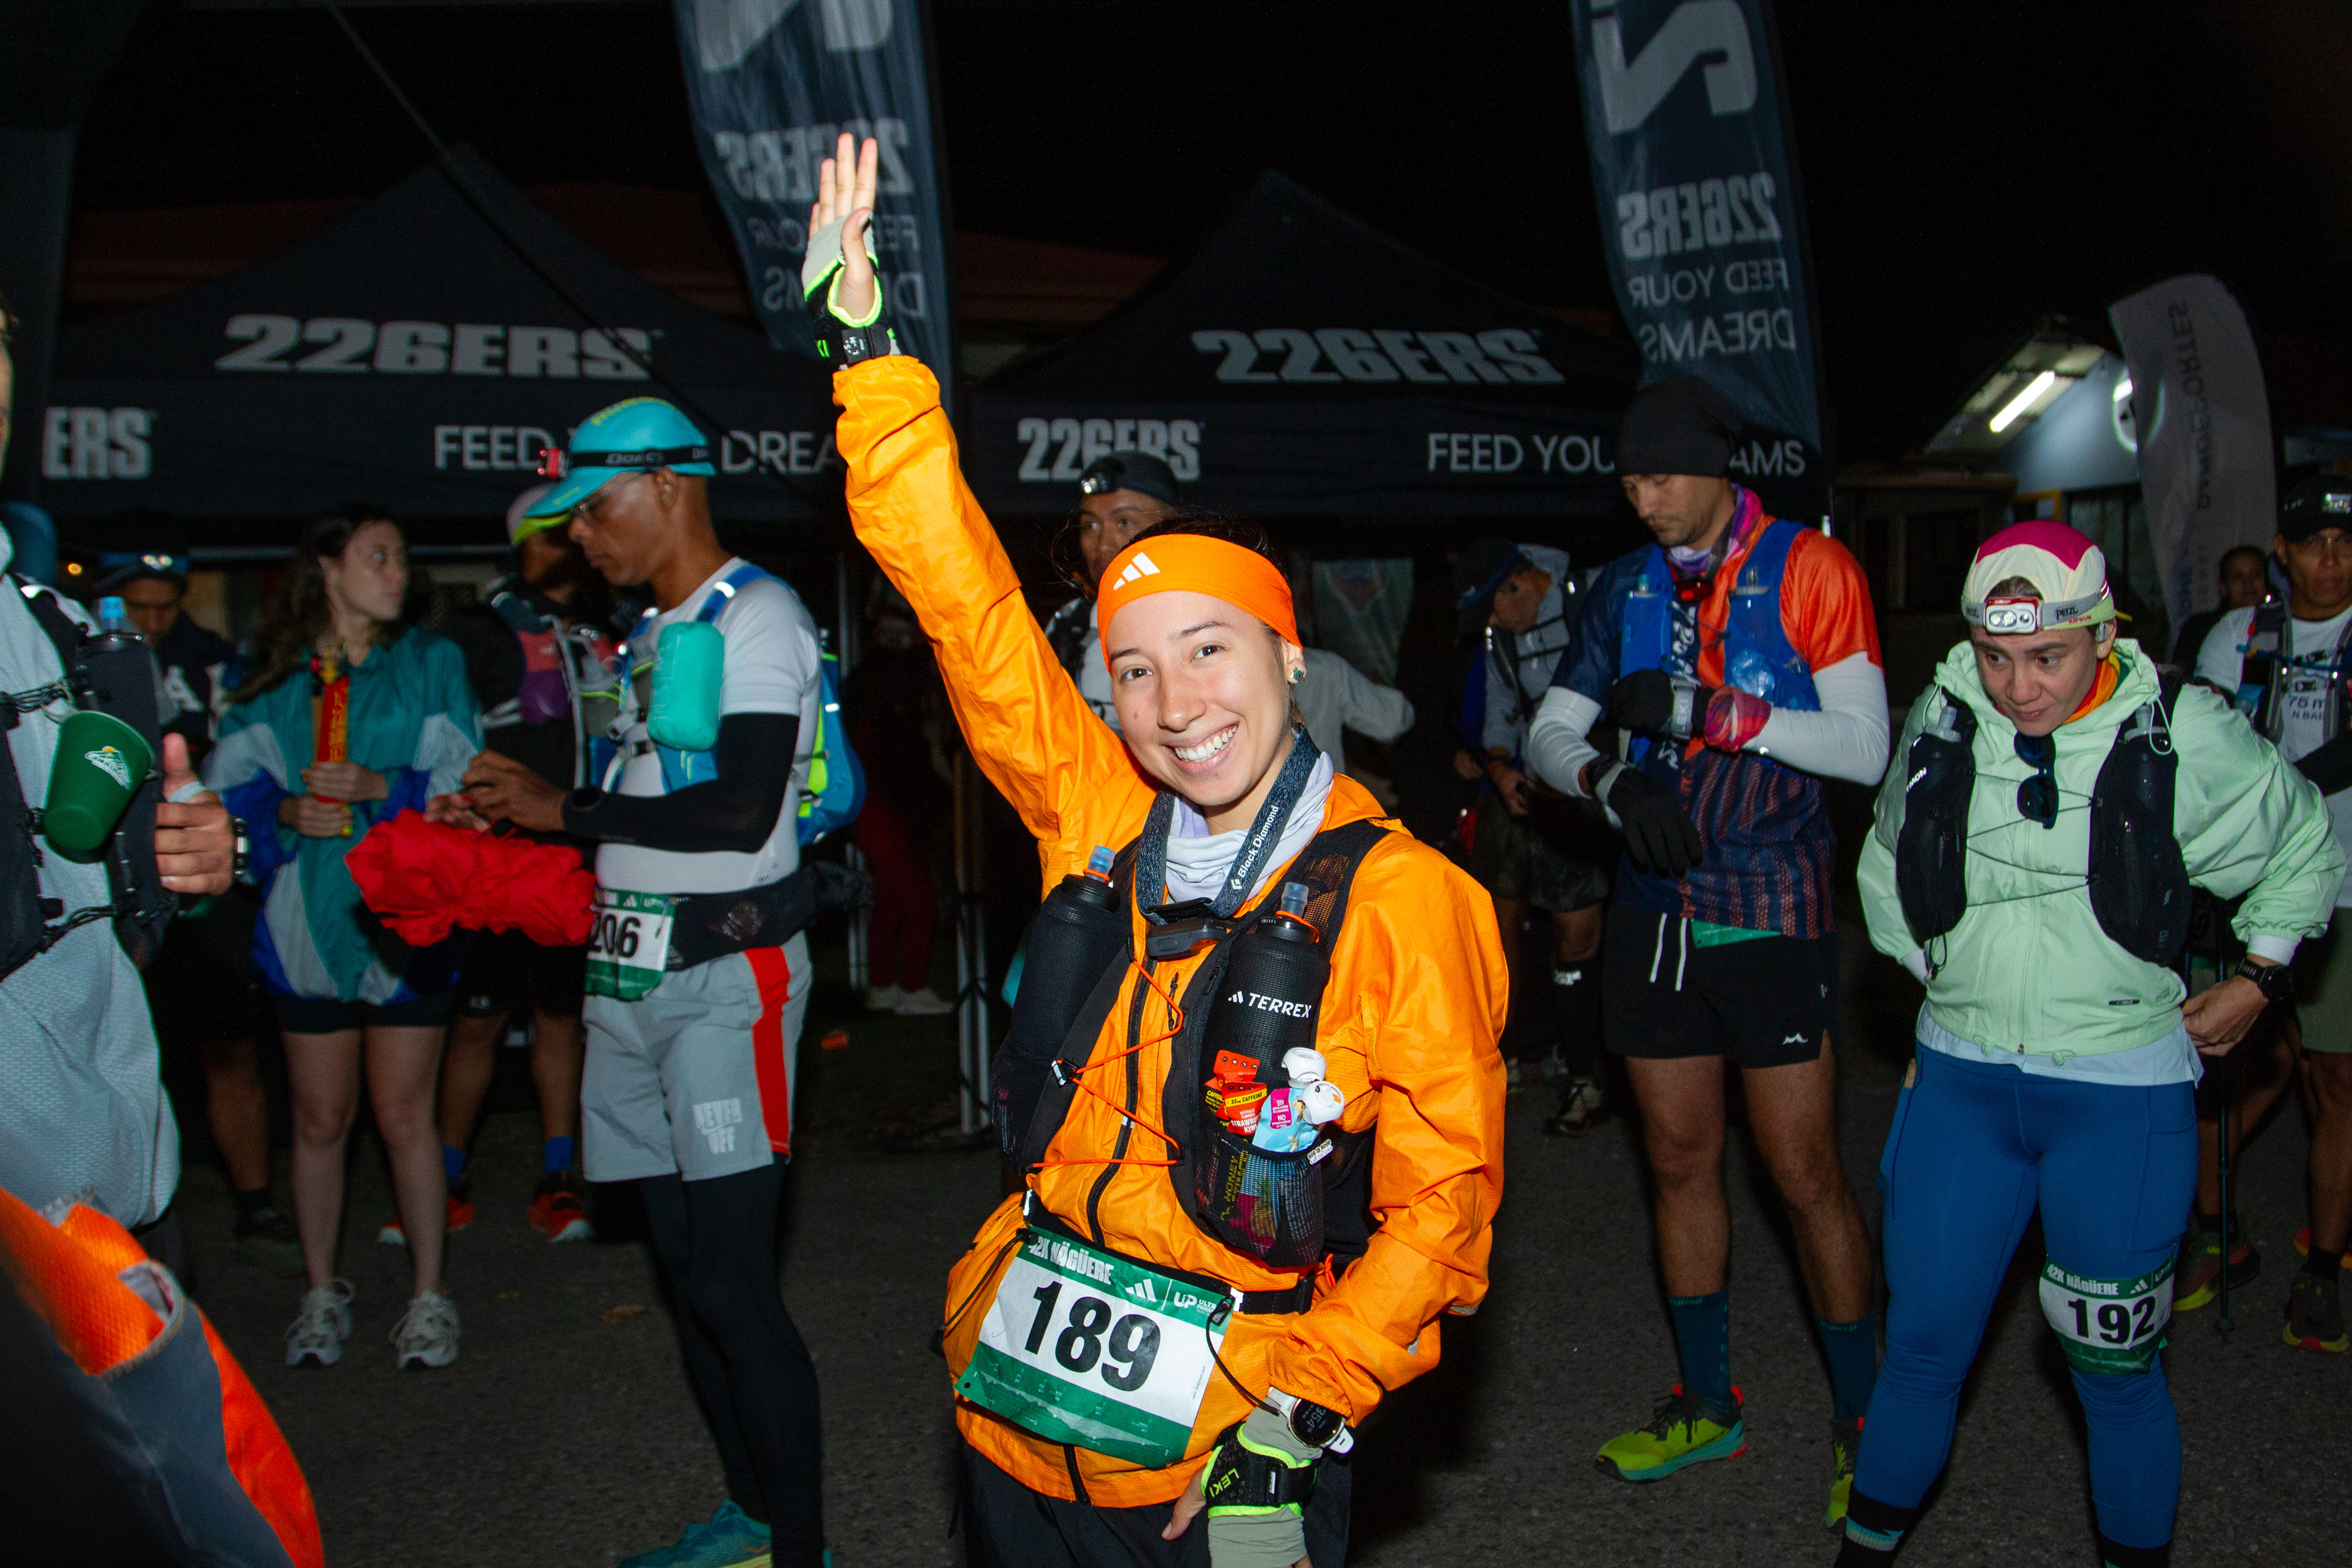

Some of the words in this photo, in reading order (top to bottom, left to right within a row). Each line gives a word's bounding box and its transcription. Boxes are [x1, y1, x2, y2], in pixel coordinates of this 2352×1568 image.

[213, 313, 653, 381] 226ERS
[1191, 327, 1565, 385] 226ERS
[434, 424, 557, 471] FEED
[721, 430, 847, 472] DREA
[1017, 417, 1201, 482] 226ERS
[1427, 433, 1524, 473] FEED
[1532, 434, 1616, 474] YOU
[1729, 439, 1807, 477] AMS
[1237, 848, 1259, 878] Black
[1252, 805, 1279, 848] Diamond
[587, 911, 641, 959] 206
[1248, 992, 1312, 1018] TERREX
[1242, 1091, 1262, 1102] CAFFEINE
[1230, 1115, 1259, 1127] STRAWBE
[1050, 1241, 1114, 1285] NÄGÜERE
[2047, 1263, 2065, 1284] 42K
[2066, 1273, 2119, 1296] NÄGÜERE
[1173, 1292, 1198, 1309] UP
[1197, 1303, 1214, 1313] PANA
[1198, 1299, 1217, 1310] ULTR
[2067, 1295, 2156, 1345] 192
[1024, 1281, 1161, 1392] 189
[1209, 1467, 1240, 1497] LEKI
